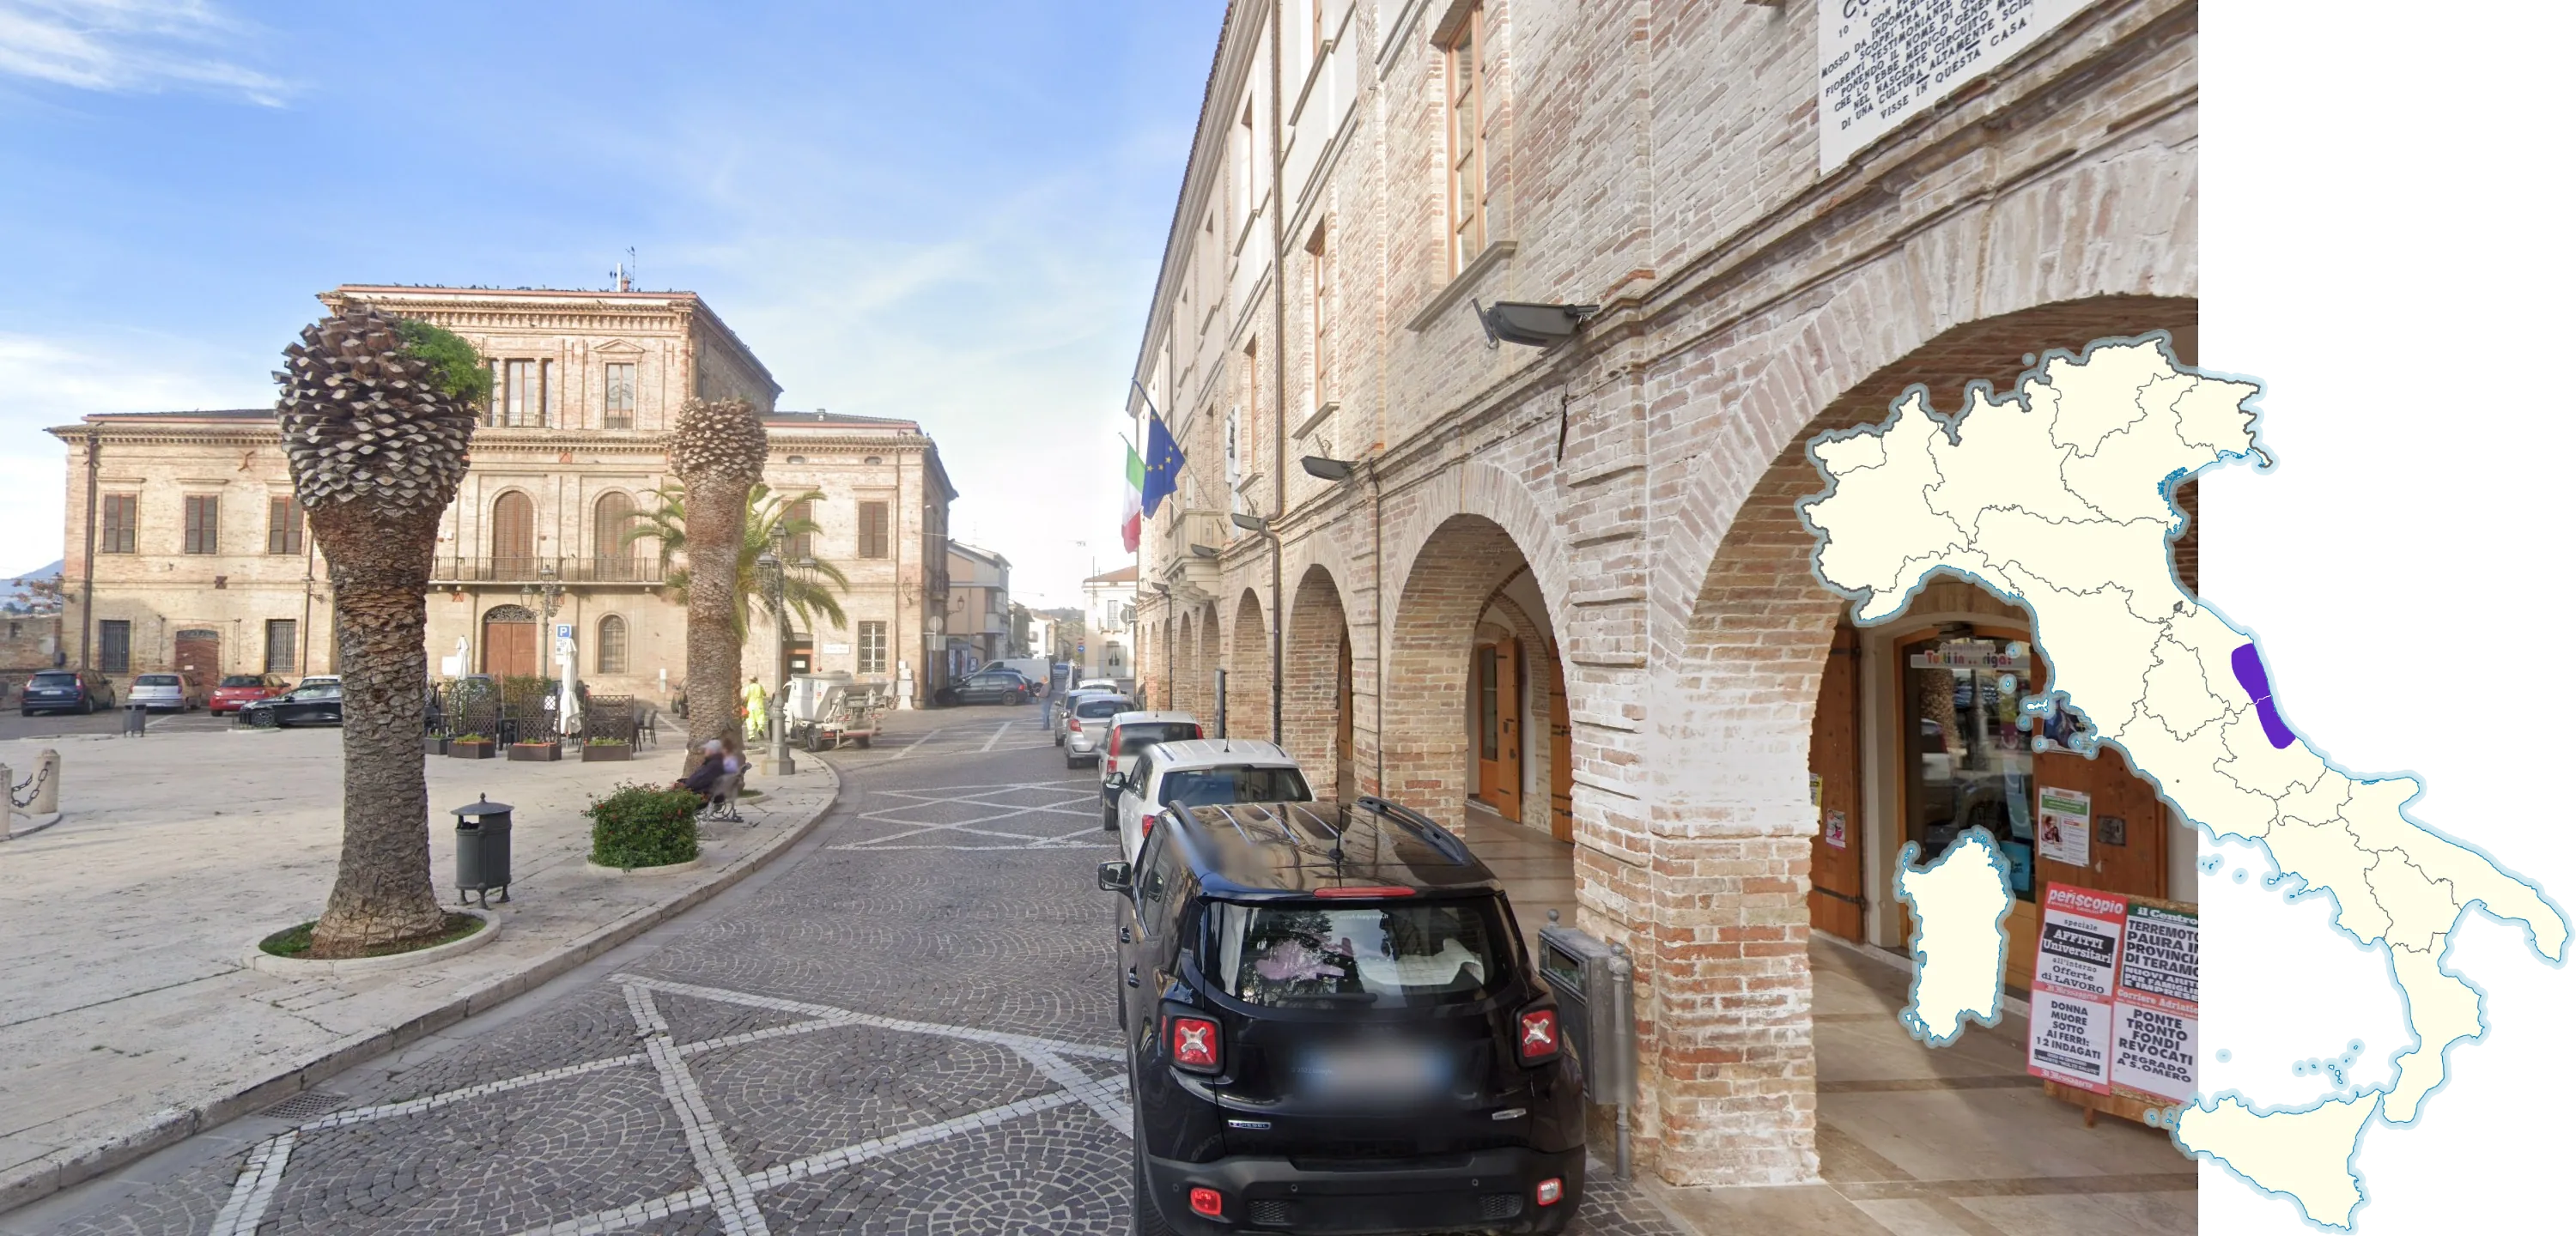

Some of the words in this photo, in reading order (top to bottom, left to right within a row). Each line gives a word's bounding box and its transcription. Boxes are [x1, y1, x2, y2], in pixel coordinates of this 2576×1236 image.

[1871, 6, 1892, 27] CON
[1899, 9, 1920, 29] TRA
[1820, 52, 1850, 79] MOSSO
[1854, 38, 1868, 53] DA
[1825, 61, 1865, 98] FIORENTI
[1870, 0, 1953, 64] TESTIMONIANZE
[1840, 60, 1885, 98] PONENDO
[1890, 49, 1900, 62] IL
[1905, 21, 1935, 51] NOME
[1941, 8, 1953, 25] DI
[1834, 94, 1852, 112] CHE
[1856, 82, 1870, 98] LO
[1874, 60, 1900, 84] EBBE
[1905, 26, 1948, 63] MEDICO
[1853, 94, 1871, 111] NEL
[1875, 52, 1928, 95] NASCENTE
[1934, 10, 1989, 53] CIRCUITO
[1880, 94, 1910, 119] VISSE
[1916, 81, 1928, 97] IN
[1935, 47, 1982, 84] QUESTA
[1990, 16, 2027, 46] CASA
[1841, 117, 1851, 130] DI
[1855, 102, 1874, 120] UNA
[1878, 68, 1923, 105] CULTURA
[1929, 17, 1996, 71] ALTAMENTE
[559, 627, 568, 637] P
[2047, 888, 2123, 914] periscopio
[2063, 918, 2098, 931] speciale
[2136, 906, 2148, 916] il
[2149, 909, 2198, 925] Centro
[2053, 929, 2104, 950] AFFITTI
[2127, 930, 2184, 951] PAURA
[2043, 938, 2111, 964] Universitari
[2125, 952, 2140, 964] DI
[2052, 956, 2098, 972] all'interno
[2052, 965, 2094, 982] Offerte
[2125, 966, 2164, 980] NUOVI
[2041, 972, 2052, 981] di
[2055, 974, 2105, 994] LAVORO
[2124, 972, 2146, 983] PER
[2148, 978, 2198, 996] FAMIGLIE
[2136, 982, 2198, 1001] IMPRESE
[2117, 989, 2157, 1004] Corriere
[2050, 1000, 2088, 1016] DONNA
[2050, 1010, 2087, 1026] MUORE
[2052, 1021, 2085, 1035] SOTTO
[2126, 1017, 2188, 1041] TRONTO
[2133, 1009, 2182, 1029] PONTE
[2046, 1029, 2057, 1039] AI
[2059, 1032, 2090, 1046] FERRI:
[2132, 1030, 2180, 1051] FONDI
[2051, 1039, 2101, 1060] INDAGATI
[2118, 1037, 2193, 1066] REVOCATI
[2122, 1051, 2187, 1075] DEGRADO
[2129, 1061, 2191, 1083] S.OMERO
